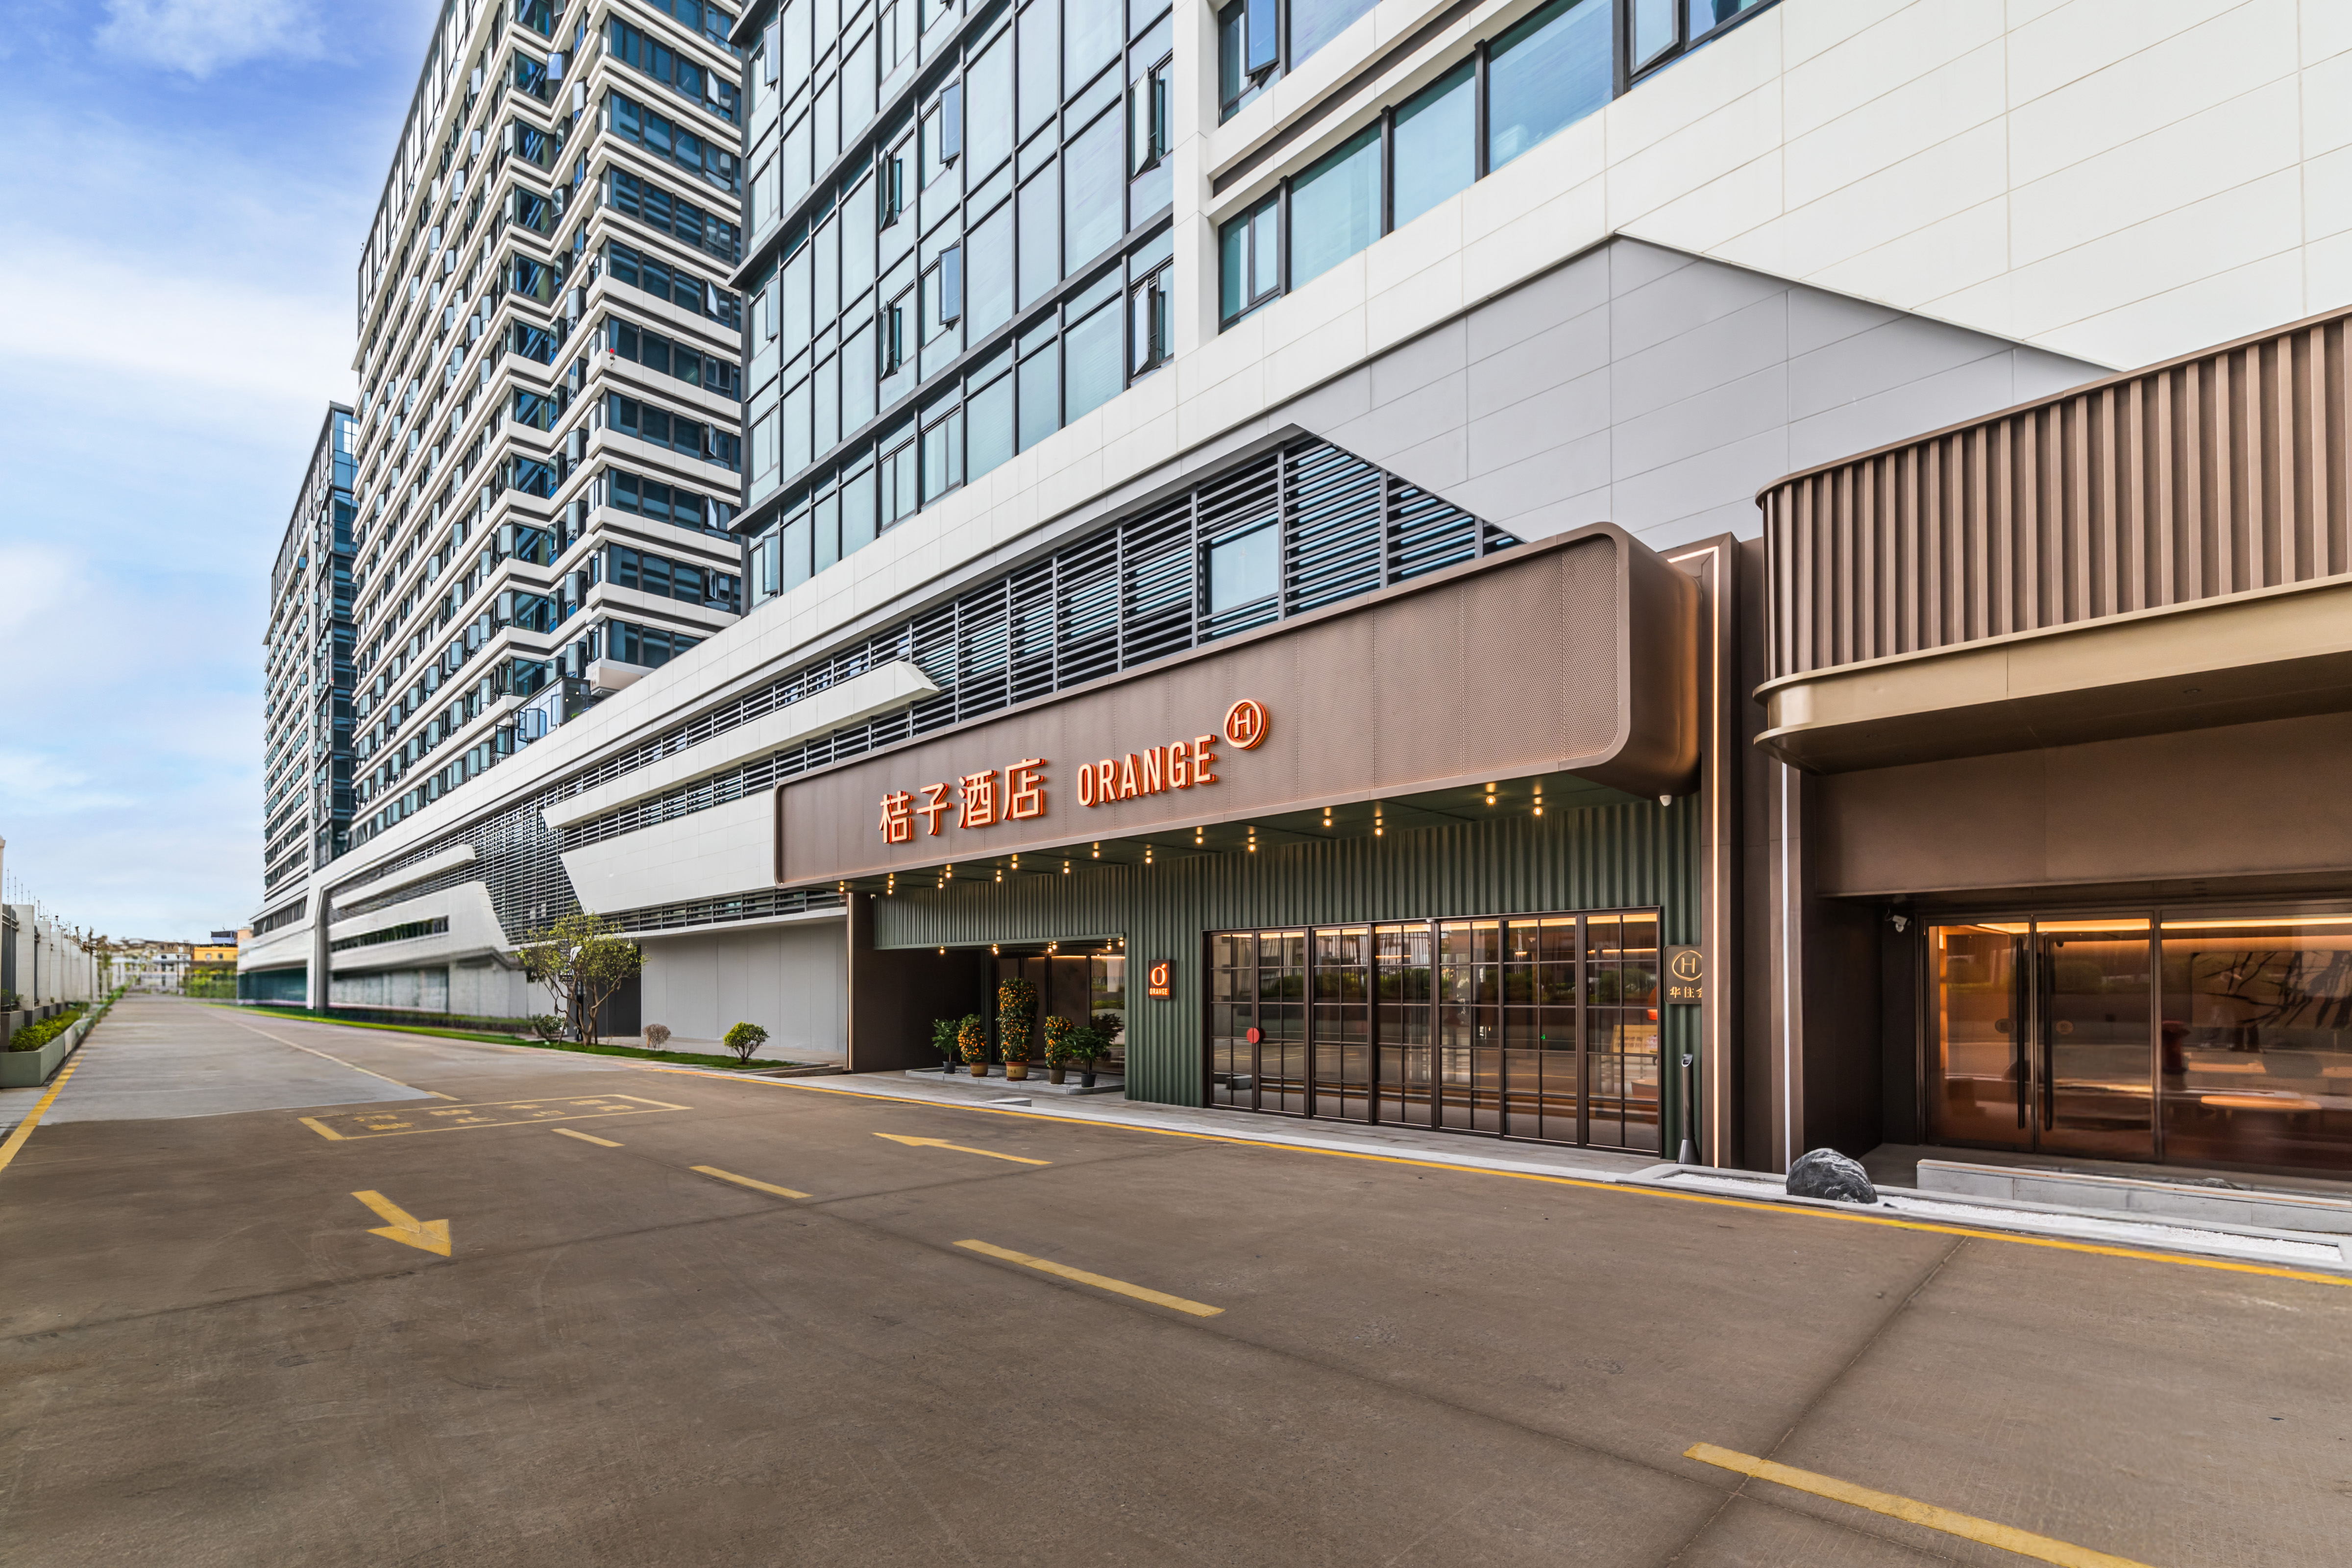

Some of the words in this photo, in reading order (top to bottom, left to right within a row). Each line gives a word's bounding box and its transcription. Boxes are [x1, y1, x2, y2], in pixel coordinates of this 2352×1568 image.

[879, 758, 1046, 843] 桔子酒店
[1078, 734, 1216, 807] ORANGE
[1681, 957, 1695, 974] H
